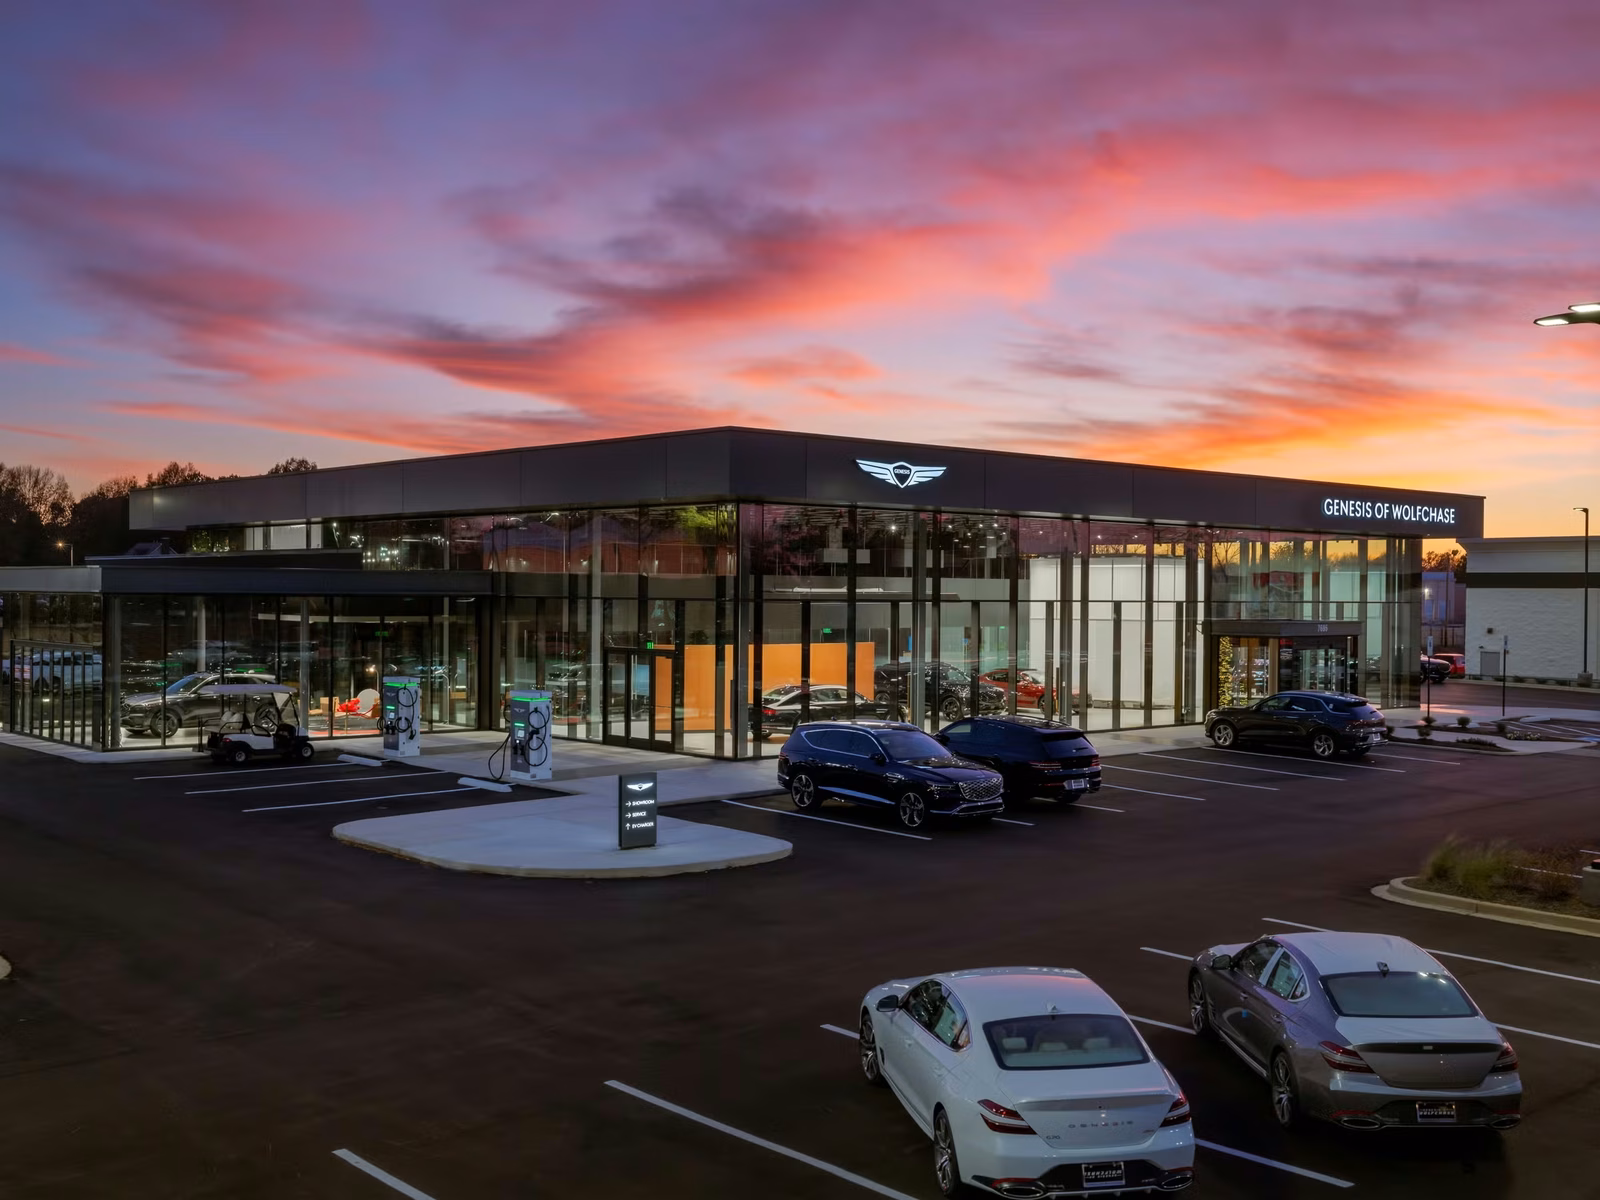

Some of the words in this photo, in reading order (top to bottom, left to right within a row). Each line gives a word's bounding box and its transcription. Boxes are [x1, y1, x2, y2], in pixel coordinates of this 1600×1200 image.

[1324, 498, 1372, 518] GENESIS
[1374, 502, 1390, 519] OF
[1391, 504, 1456, 524] WOLFCHASE
[1067, 1120, 1134, 1129] GENESIS
